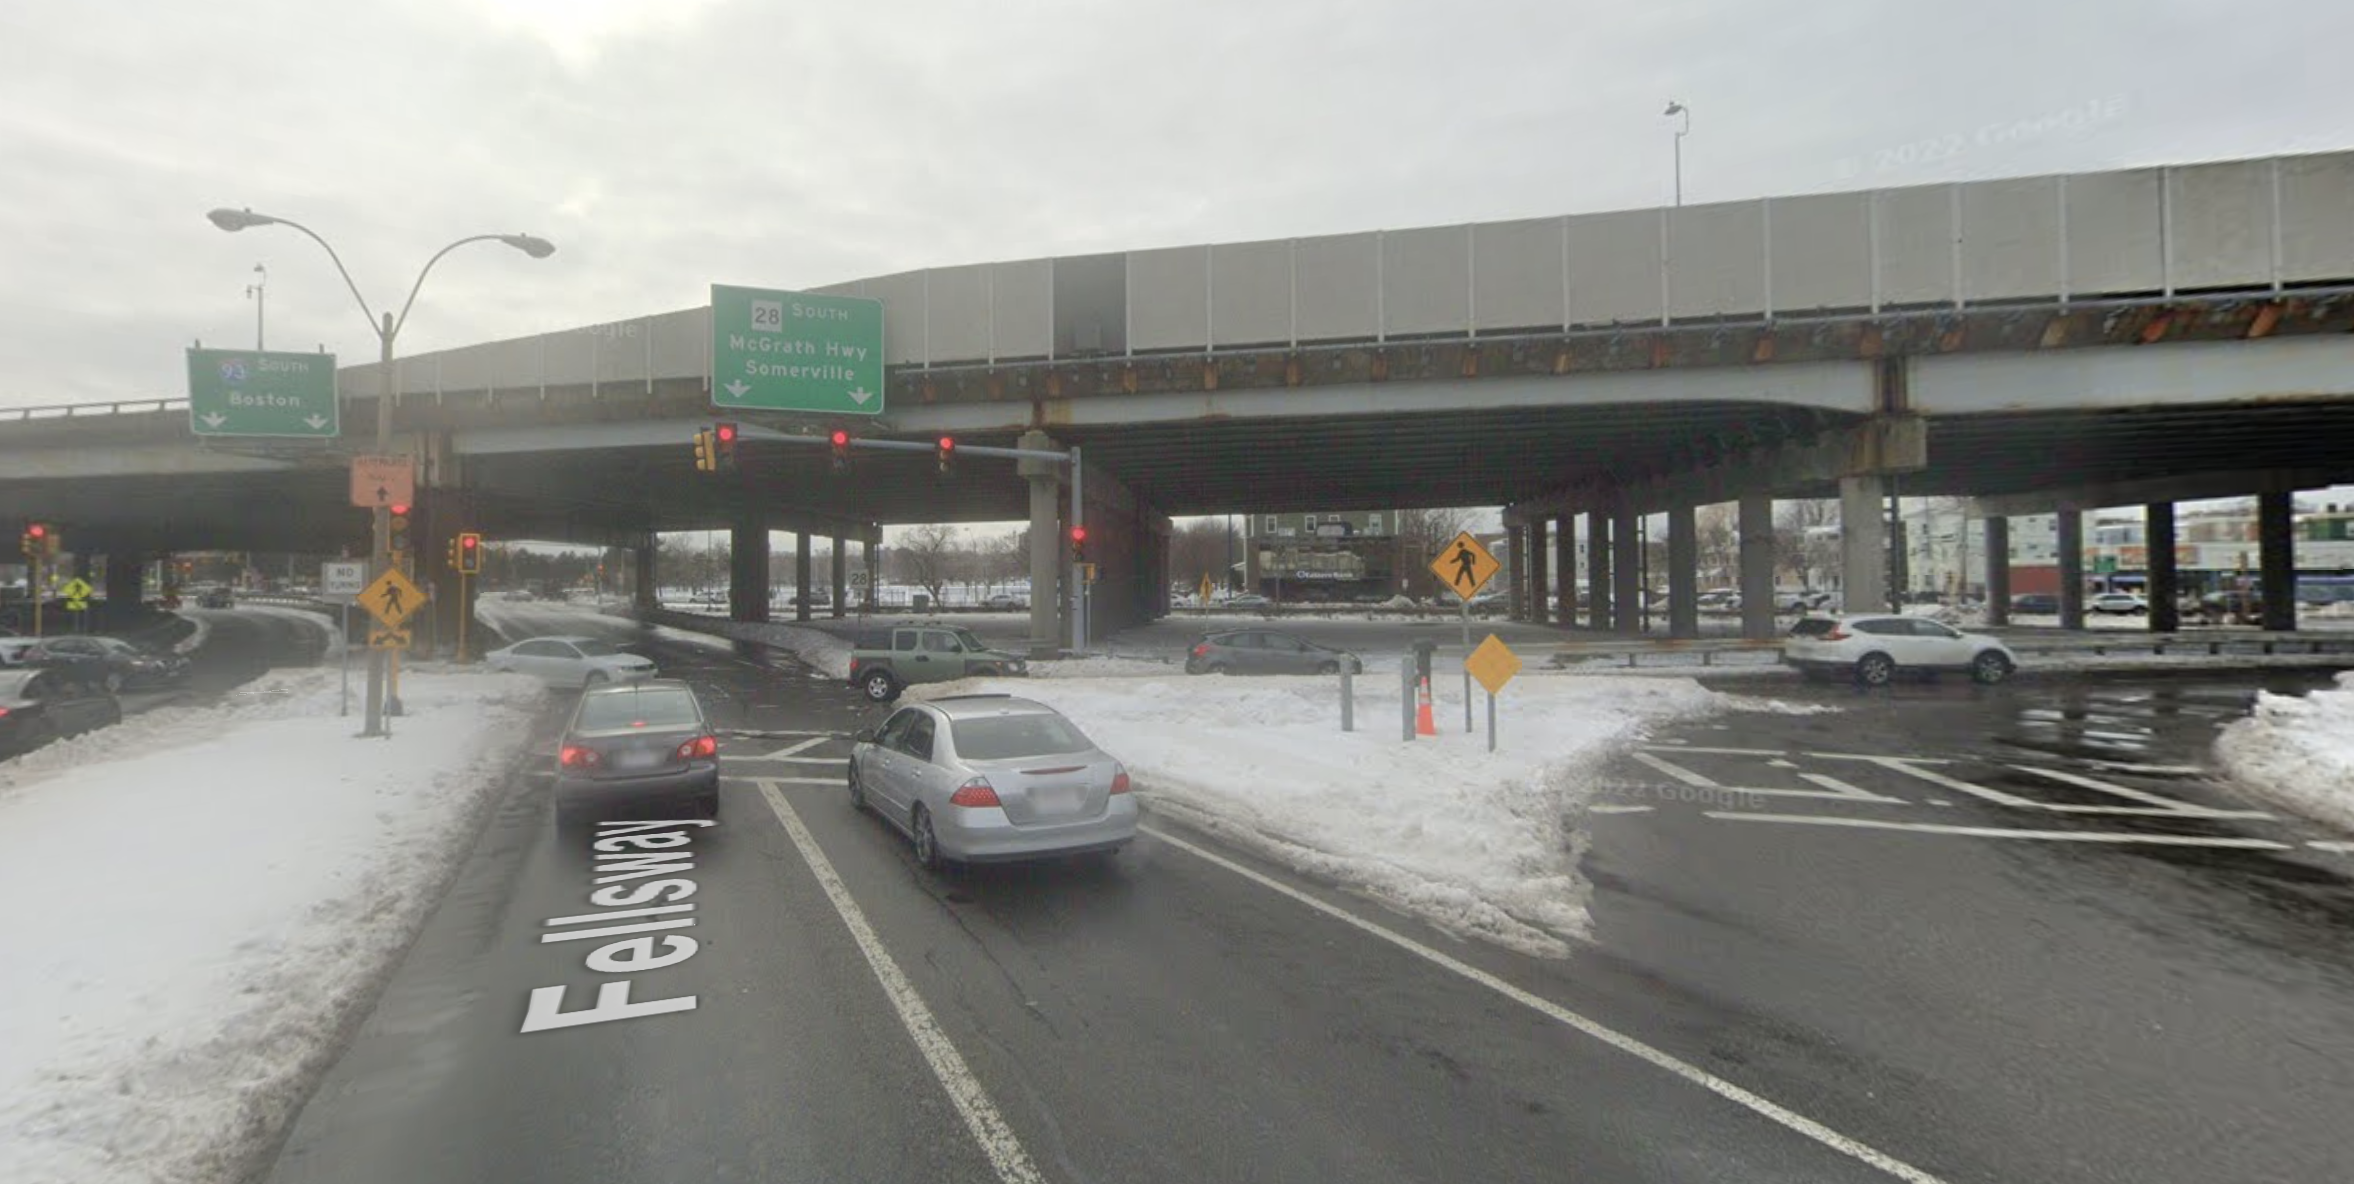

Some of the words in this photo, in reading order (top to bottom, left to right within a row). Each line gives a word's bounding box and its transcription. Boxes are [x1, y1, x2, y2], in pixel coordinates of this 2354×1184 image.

[754, 306, 780, 325] 28
[729, 334, 815, 355] McGrath
[826, 342, 868, 362] Hwy
[220, 362, 246, 380] 93
[745, 359, 855, 381] Somerville
[230, 390, 301, 408] Boston
[337, 567, 355, 578] NO
[851, 573, 867, 586] 28
